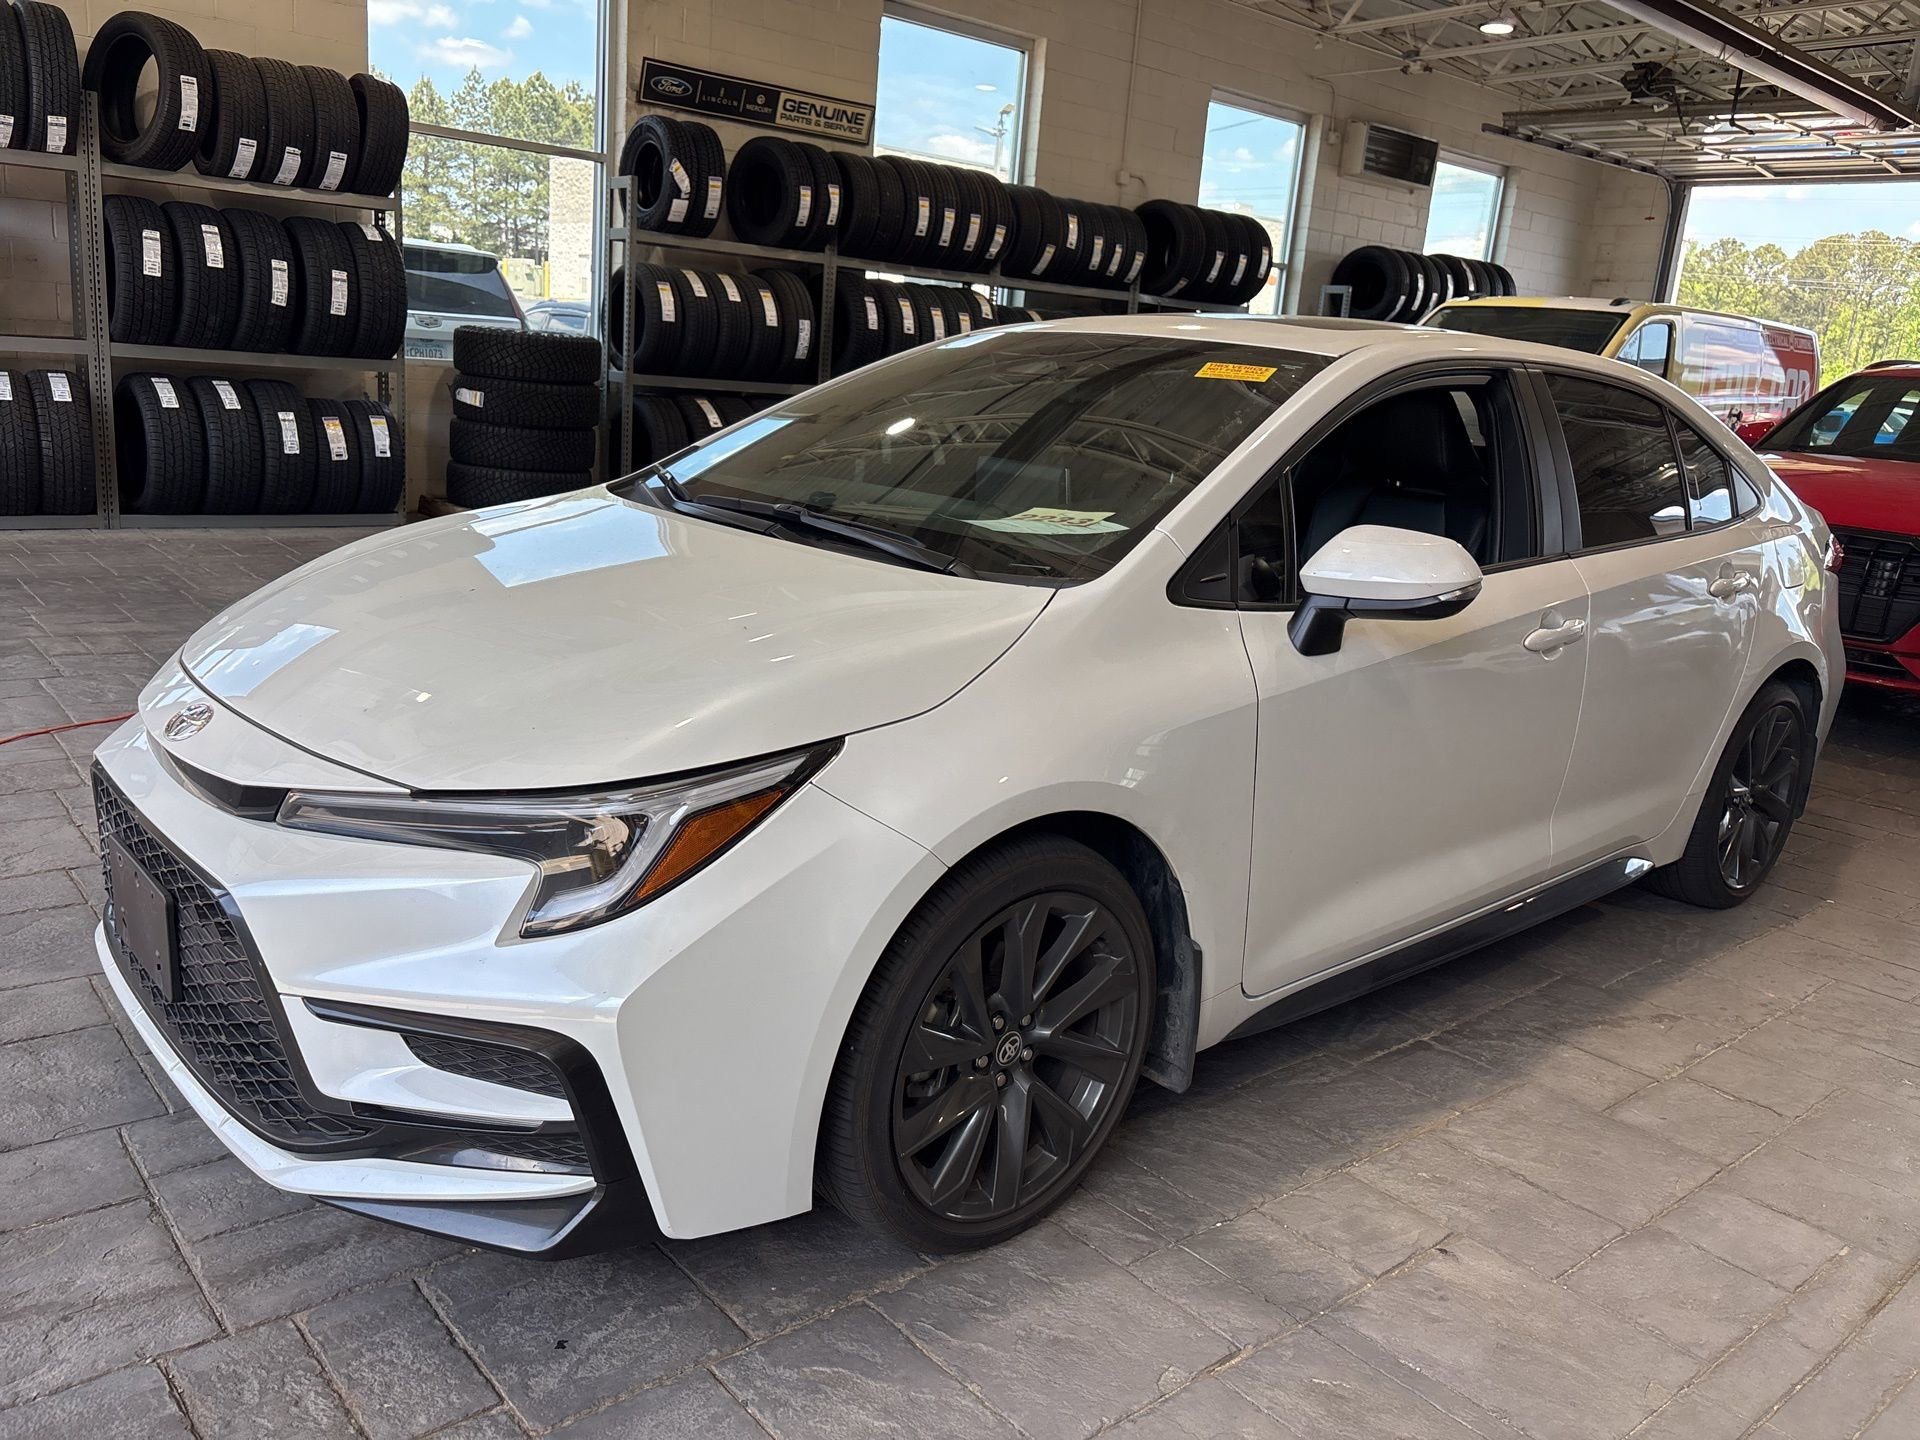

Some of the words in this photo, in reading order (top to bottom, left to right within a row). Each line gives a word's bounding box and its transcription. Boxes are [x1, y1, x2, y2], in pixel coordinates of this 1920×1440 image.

[657, 78, 685, 96] Ford
[702, 95, 739, 107] LINCOLN
[746, 103, 773, 114] MERCURY
[782, 97, 866, 126] GENUINE
[780, 113, 812, 127] PARTS
[813, 119, 822, 128] &
[823, 121, 863, 135] SERVICE
